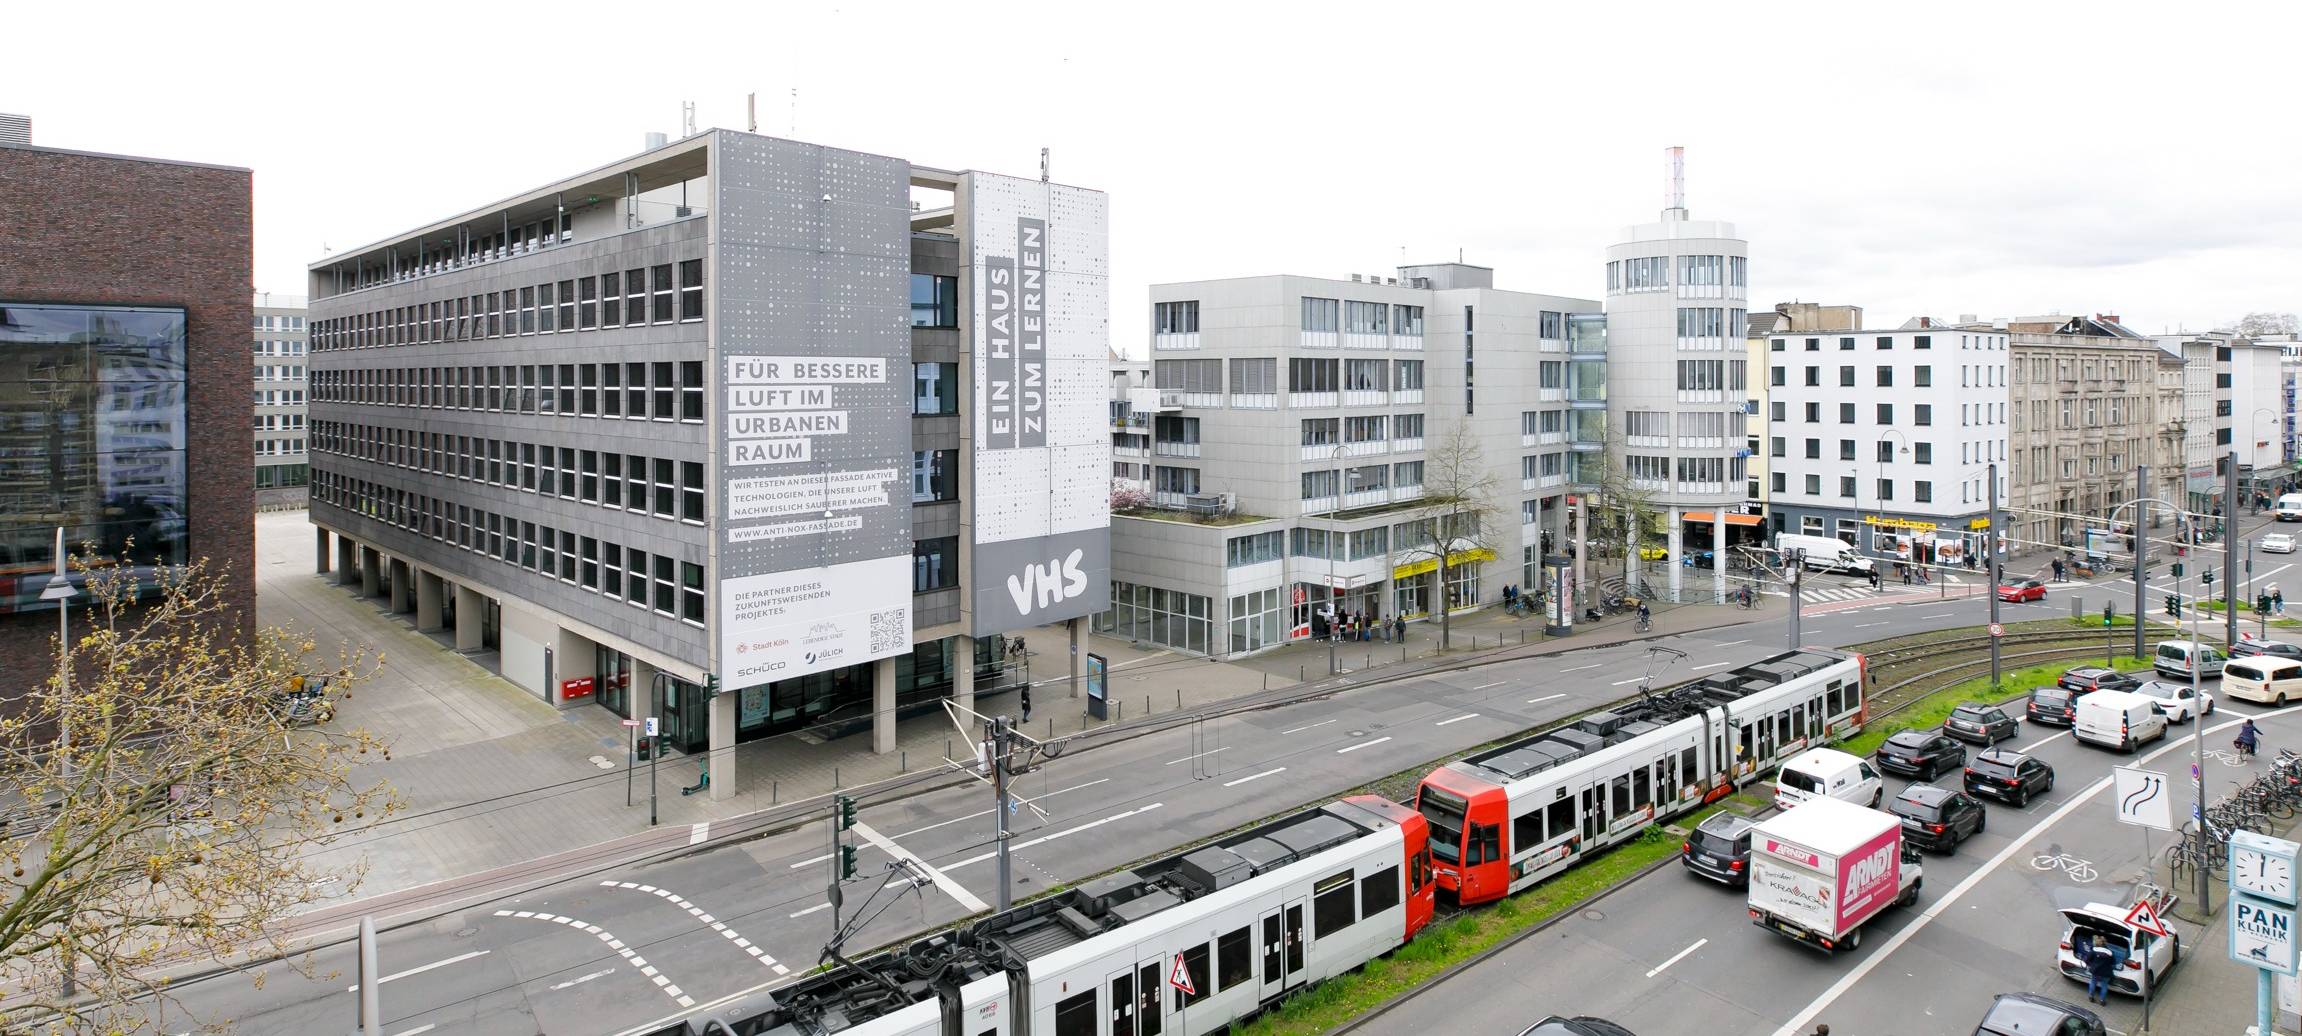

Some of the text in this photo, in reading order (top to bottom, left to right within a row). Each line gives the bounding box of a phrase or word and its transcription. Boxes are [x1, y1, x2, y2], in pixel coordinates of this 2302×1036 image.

[1024, 227, 1042, 433] ZUM LERNEN
[991, 268, 1010, 434] EIN HAUS
[736, 358, 880, 379] FÜR BESSERE
[736, 390, 824, 406] LUFT IM
[736, 416, 840, 434] URBANEN
[736, 443, 802, 462] RAUM
[734, 472, 893, 490] WIR TESTEN AN DIESER FASSADE AKTIVE
[734, 484, 877, 502] TECHNOLOGIEN, DIE UNSERE LUFT
[734, 504, 803, 516] NACHWEISLICH
[806, 500, 847, 510] SAUBERER
[734, 520, 858, 538] WWW.ANTI-NOX-FASSADE.DE
[736, 582, 822, 601] DIE PARTNER DIESES
[1007, 548, 1088, 616] VHS
[736, 590, 831, 611] ZUKUNFTSWEISENDEN
[752, 639, 789, 651] Stadt Köln
[818, 648, 844, 658] JÜLICH
[737, 661, 786, 677] SCHÜCO
[1775, 844, 1812, 864] ARNDT
[1842, 841, 1895, 906] ARNDT
[2238, 904, 2287, 931] PAN
[2238, 920, 2287, 940] KLINIK
